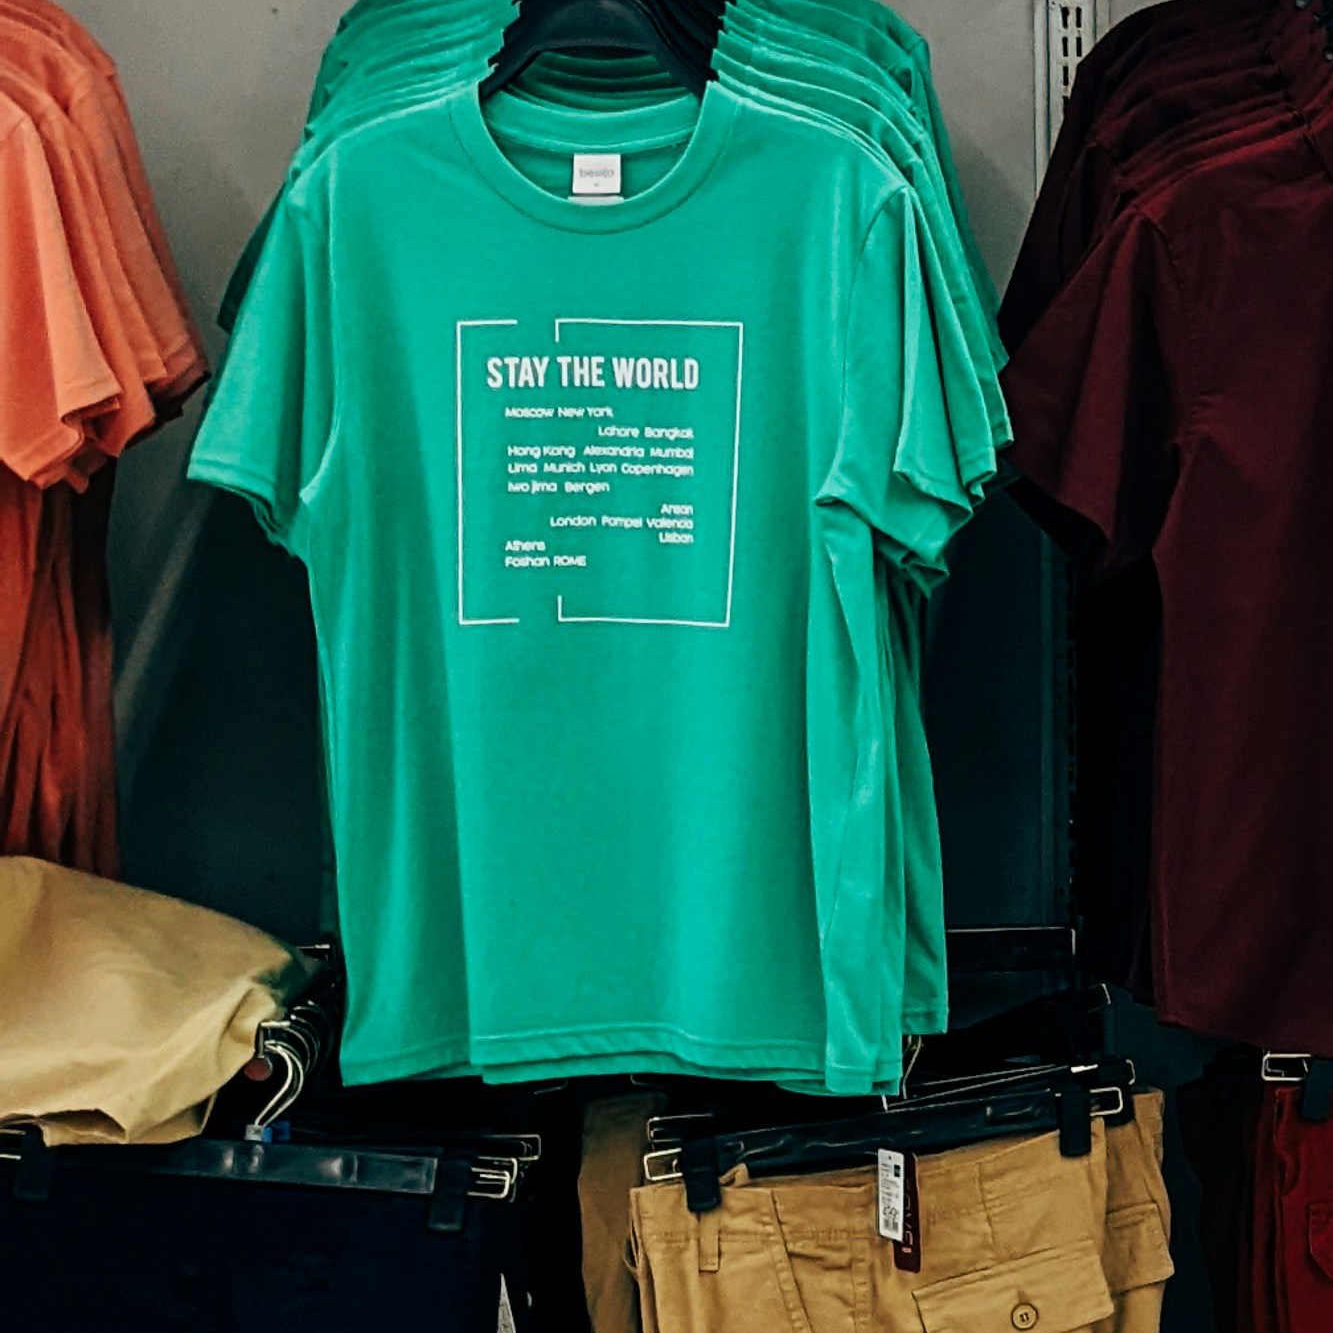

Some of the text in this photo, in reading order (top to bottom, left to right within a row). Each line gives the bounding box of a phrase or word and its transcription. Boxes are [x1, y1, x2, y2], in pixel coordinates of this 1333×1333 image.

[487, 356, 698, 389] STAY THE WORLD
[505, 407, 613, 418] Moscow New York
[598, 426, 639, 437] Lahore
[508, 446, 541, 458] Hong
[543, 446, 575, 458] Kong
[544, 462, 585, 473] Munich
[590, 463, 617, 473] Lyon
[621, 463, 693, 477] Copenhagen
[565, 482, 609, 494] Bergen
[550, 516, 596, 526] London
[554, 555, 586, 566] ROME
